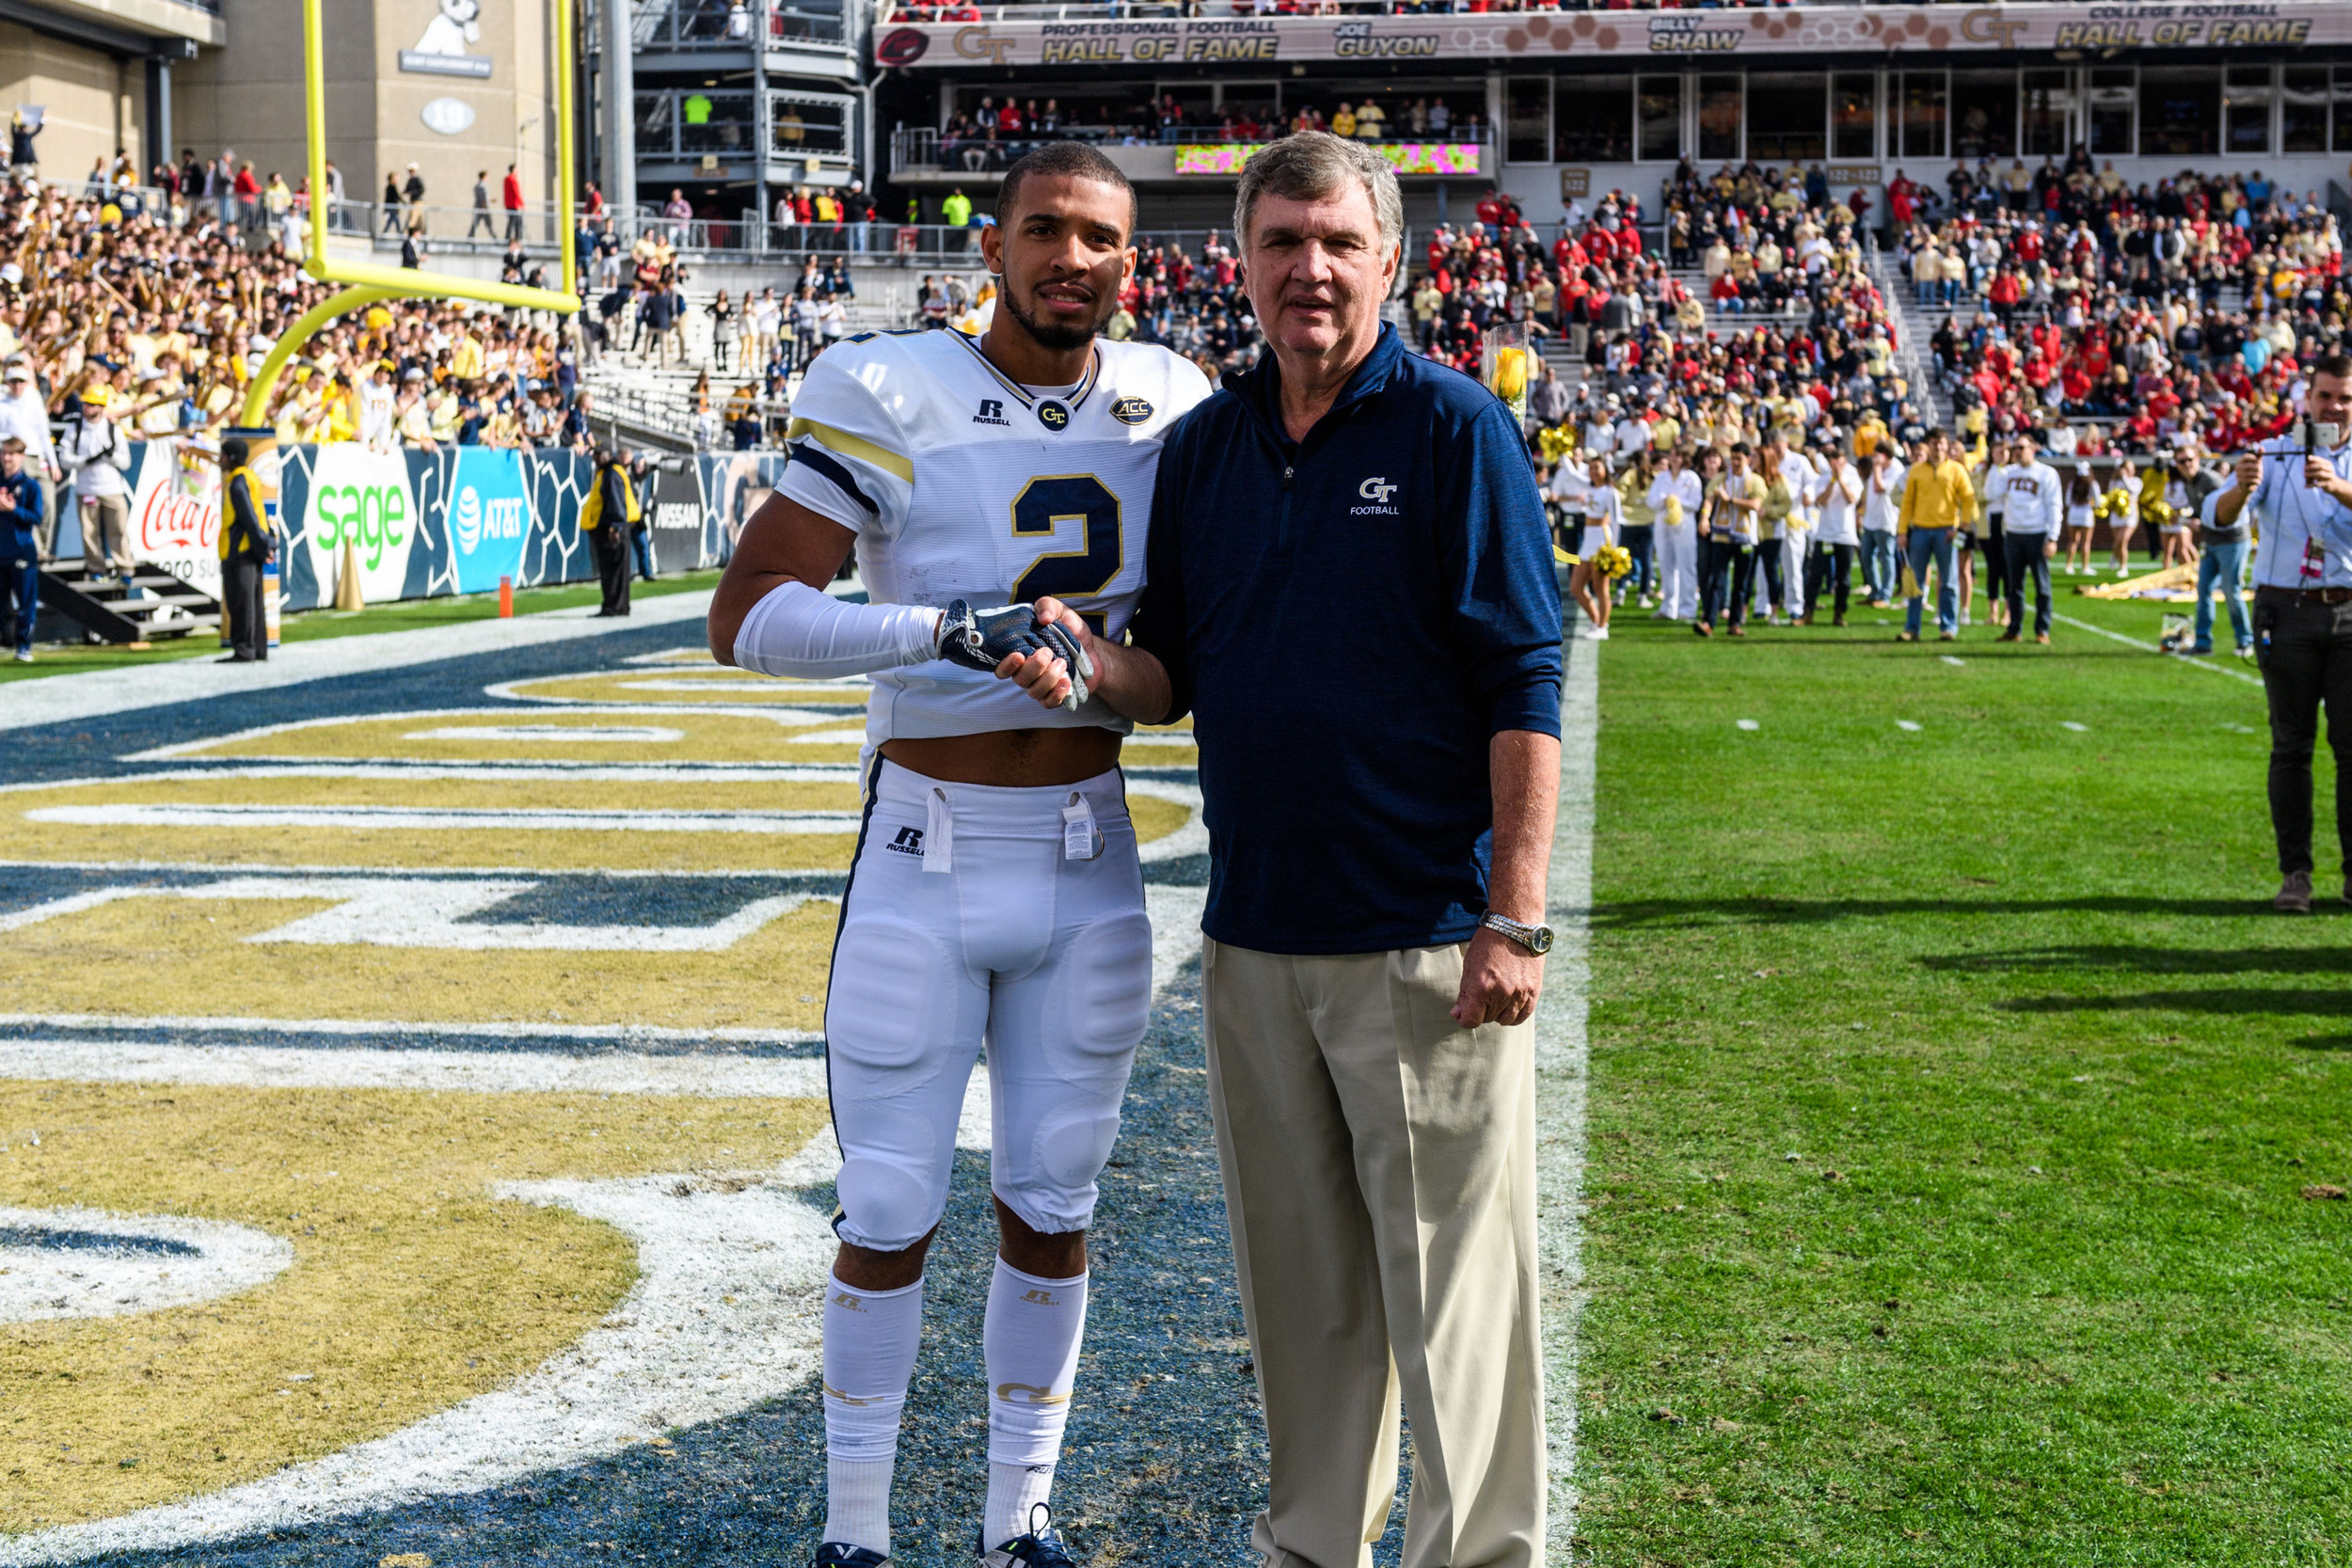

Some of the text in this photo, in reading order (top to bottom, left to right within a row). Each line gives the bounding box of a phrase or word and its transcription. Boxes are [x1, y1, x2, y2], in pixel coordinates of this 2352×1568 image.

[2090, 4, 2280, 19] COLLEGE FOOTBALL
[1041, 21, 1278, 37] PROFESSIONAL FOOTBALL
[1333, 23, 1373, 38] JOE
[2055, 17, 2314, 49] HALL OF FAME
[1041, 36, 1280, 63] HALL OF FAME
[1334, 35, 1439, 57] GUYON
[1649, 29, 1744, 52] SHAW
[1041, 407, 1066, 424] GT
[1117, 402, 1149, 414] ACC
[973, 415, 1011, 426] RUSSELL
[1359, 477, 1398, 503] GT
[483, 498, 523, 540] AT&T
[655, 502, 700, 529] NISSAN
[1350, 505, 1400, 515] FOOTBALL
[316, 484, 405, 571] sage
[157, 560, 194, 578] ero
